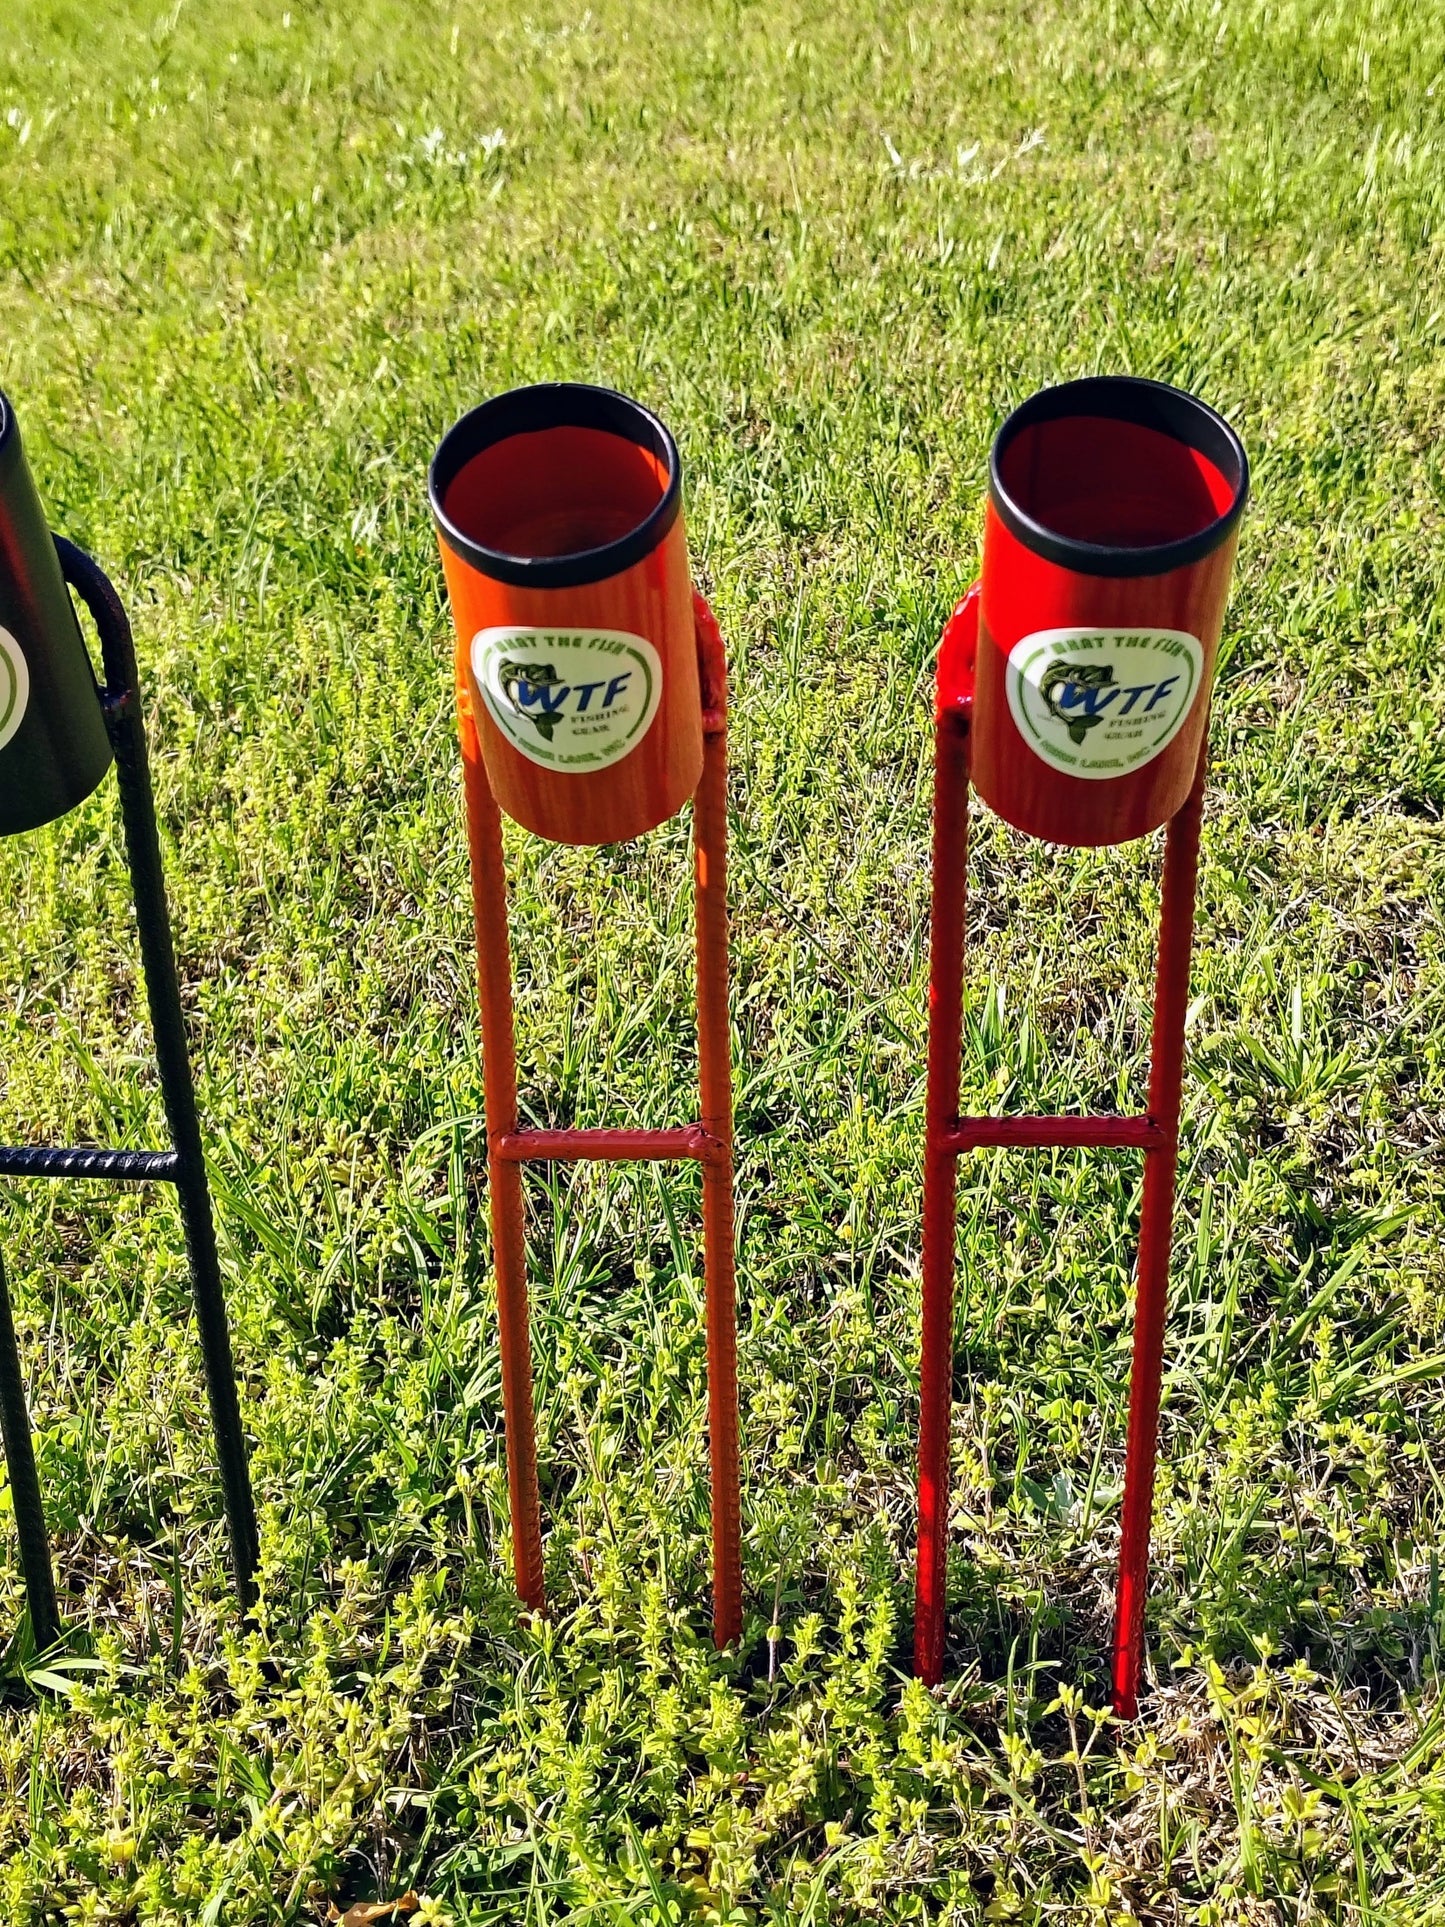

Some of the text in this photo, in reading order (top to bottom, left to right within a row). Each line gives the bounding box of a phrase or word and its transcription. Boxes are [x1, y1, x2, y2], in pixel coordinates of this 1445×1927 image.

[543, 635, 582, 648] THE
[588, 637, 627, 656] FISH
[1114, 636, 1152, 649] THE
[1153, 637, 1187, 658] FISH
[518, 672, 633, 713] WTF
[1059, 675, 1181, 716] WTF
[570, 705, 630, 724] FISHING
[1108, 710, 1168, 728] FISHING
